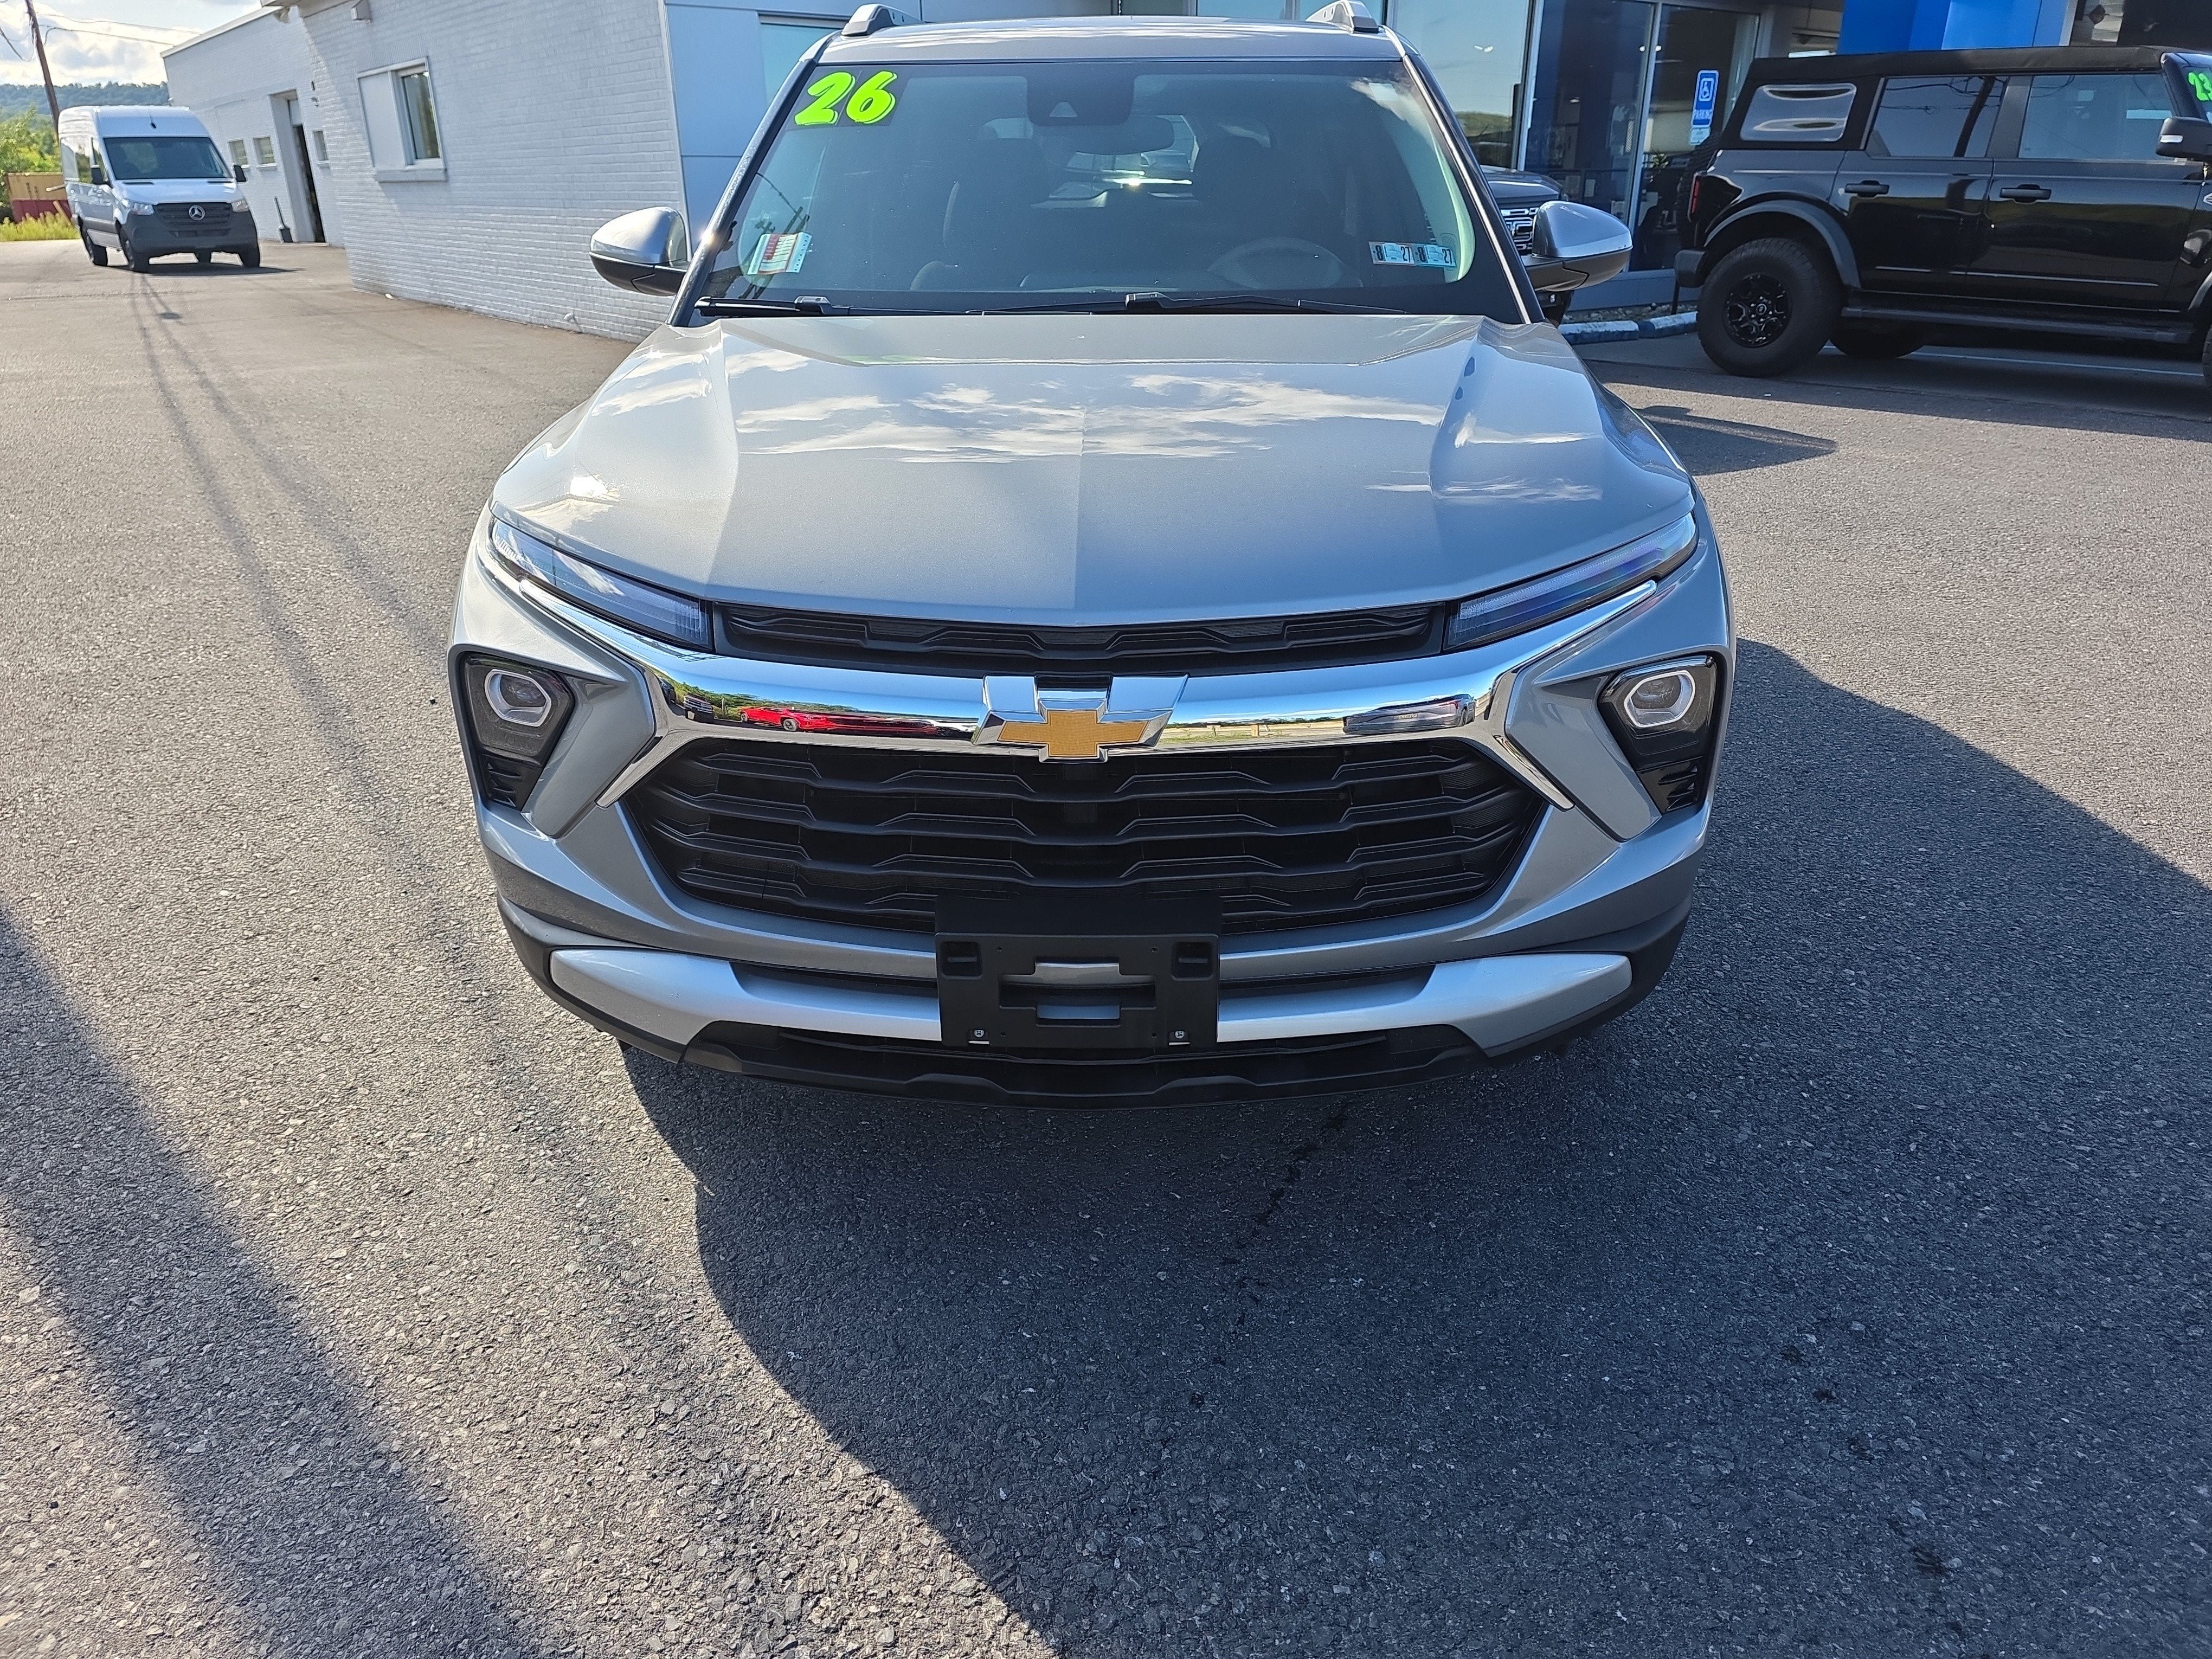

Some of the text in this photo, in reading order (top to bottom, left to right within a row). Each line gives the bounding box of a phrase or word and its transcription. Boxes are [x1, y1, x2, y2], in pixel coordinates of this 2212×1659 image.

[794, 70, 898, 126] 26
[1375, 245, 1384, 261] 8
[1400, 246, 1411, 263] 27
[1417, 246, 1426, 262] 8
[1442, 248, 1452, 265] 27
